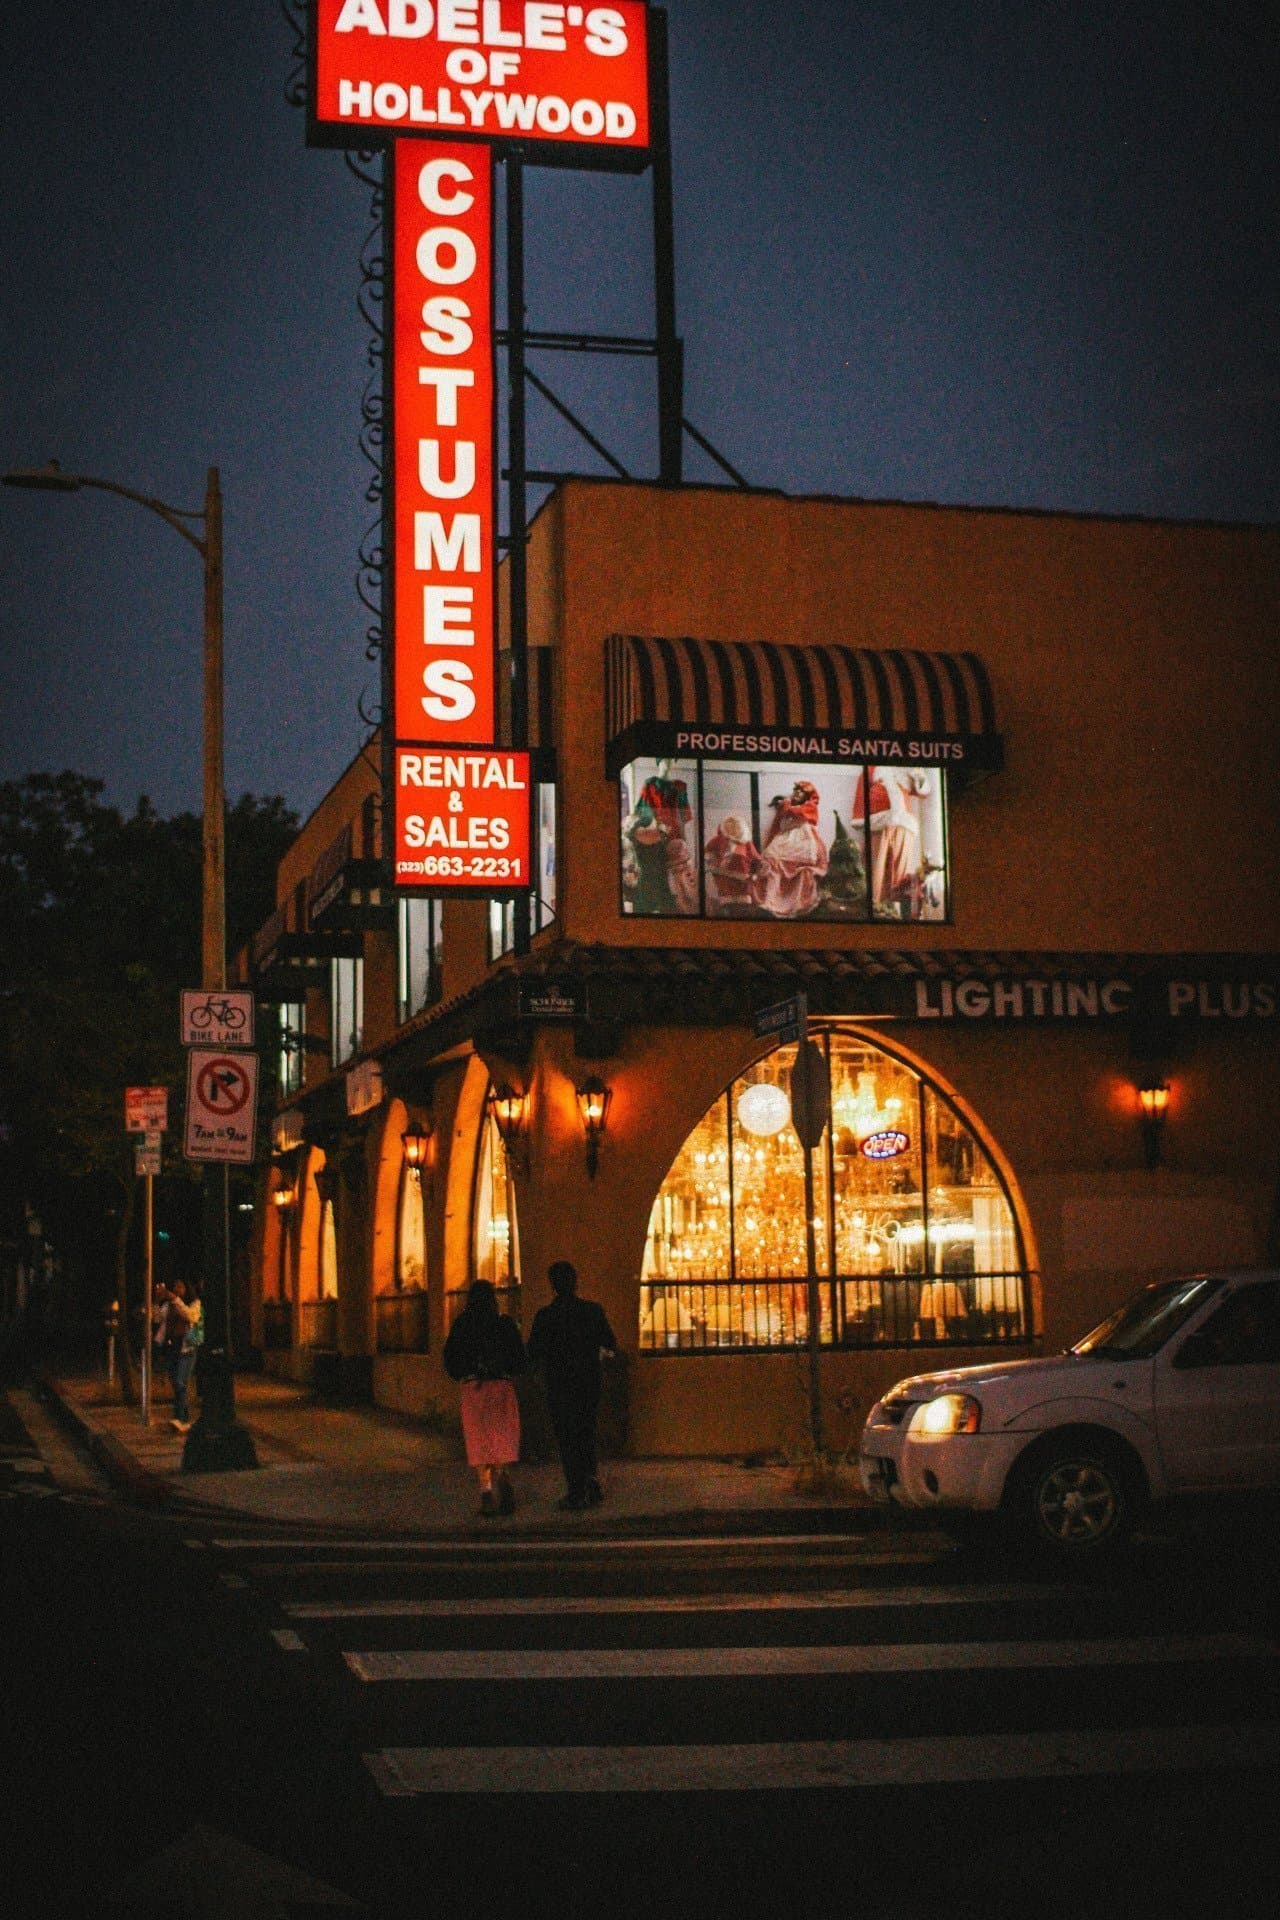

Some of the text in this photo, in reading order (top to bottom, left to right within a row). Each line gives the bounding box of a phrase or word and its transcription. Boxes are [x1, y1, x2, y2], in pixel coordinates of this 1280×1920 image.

[335, 0, 628, 57] ADELE'S
[446, 48, 521, 86] OF
[339, 79, 636, 138] HOLLYWOOD
[415, 159, 481, 721] COSTUMES
[677, 733, 964, 760] PROFESSIONAL SANTA SUITS
[400, 755, 525, 790] RENTAL
[447, 791, 464, 812] &
[404, 815, 510, 850] SALES
[1167, 982, 1276, 1017] PLUS
[190, 1031, 243, 1042] BIKE LANE
[863, 1136, 908, 1152] OPEN
